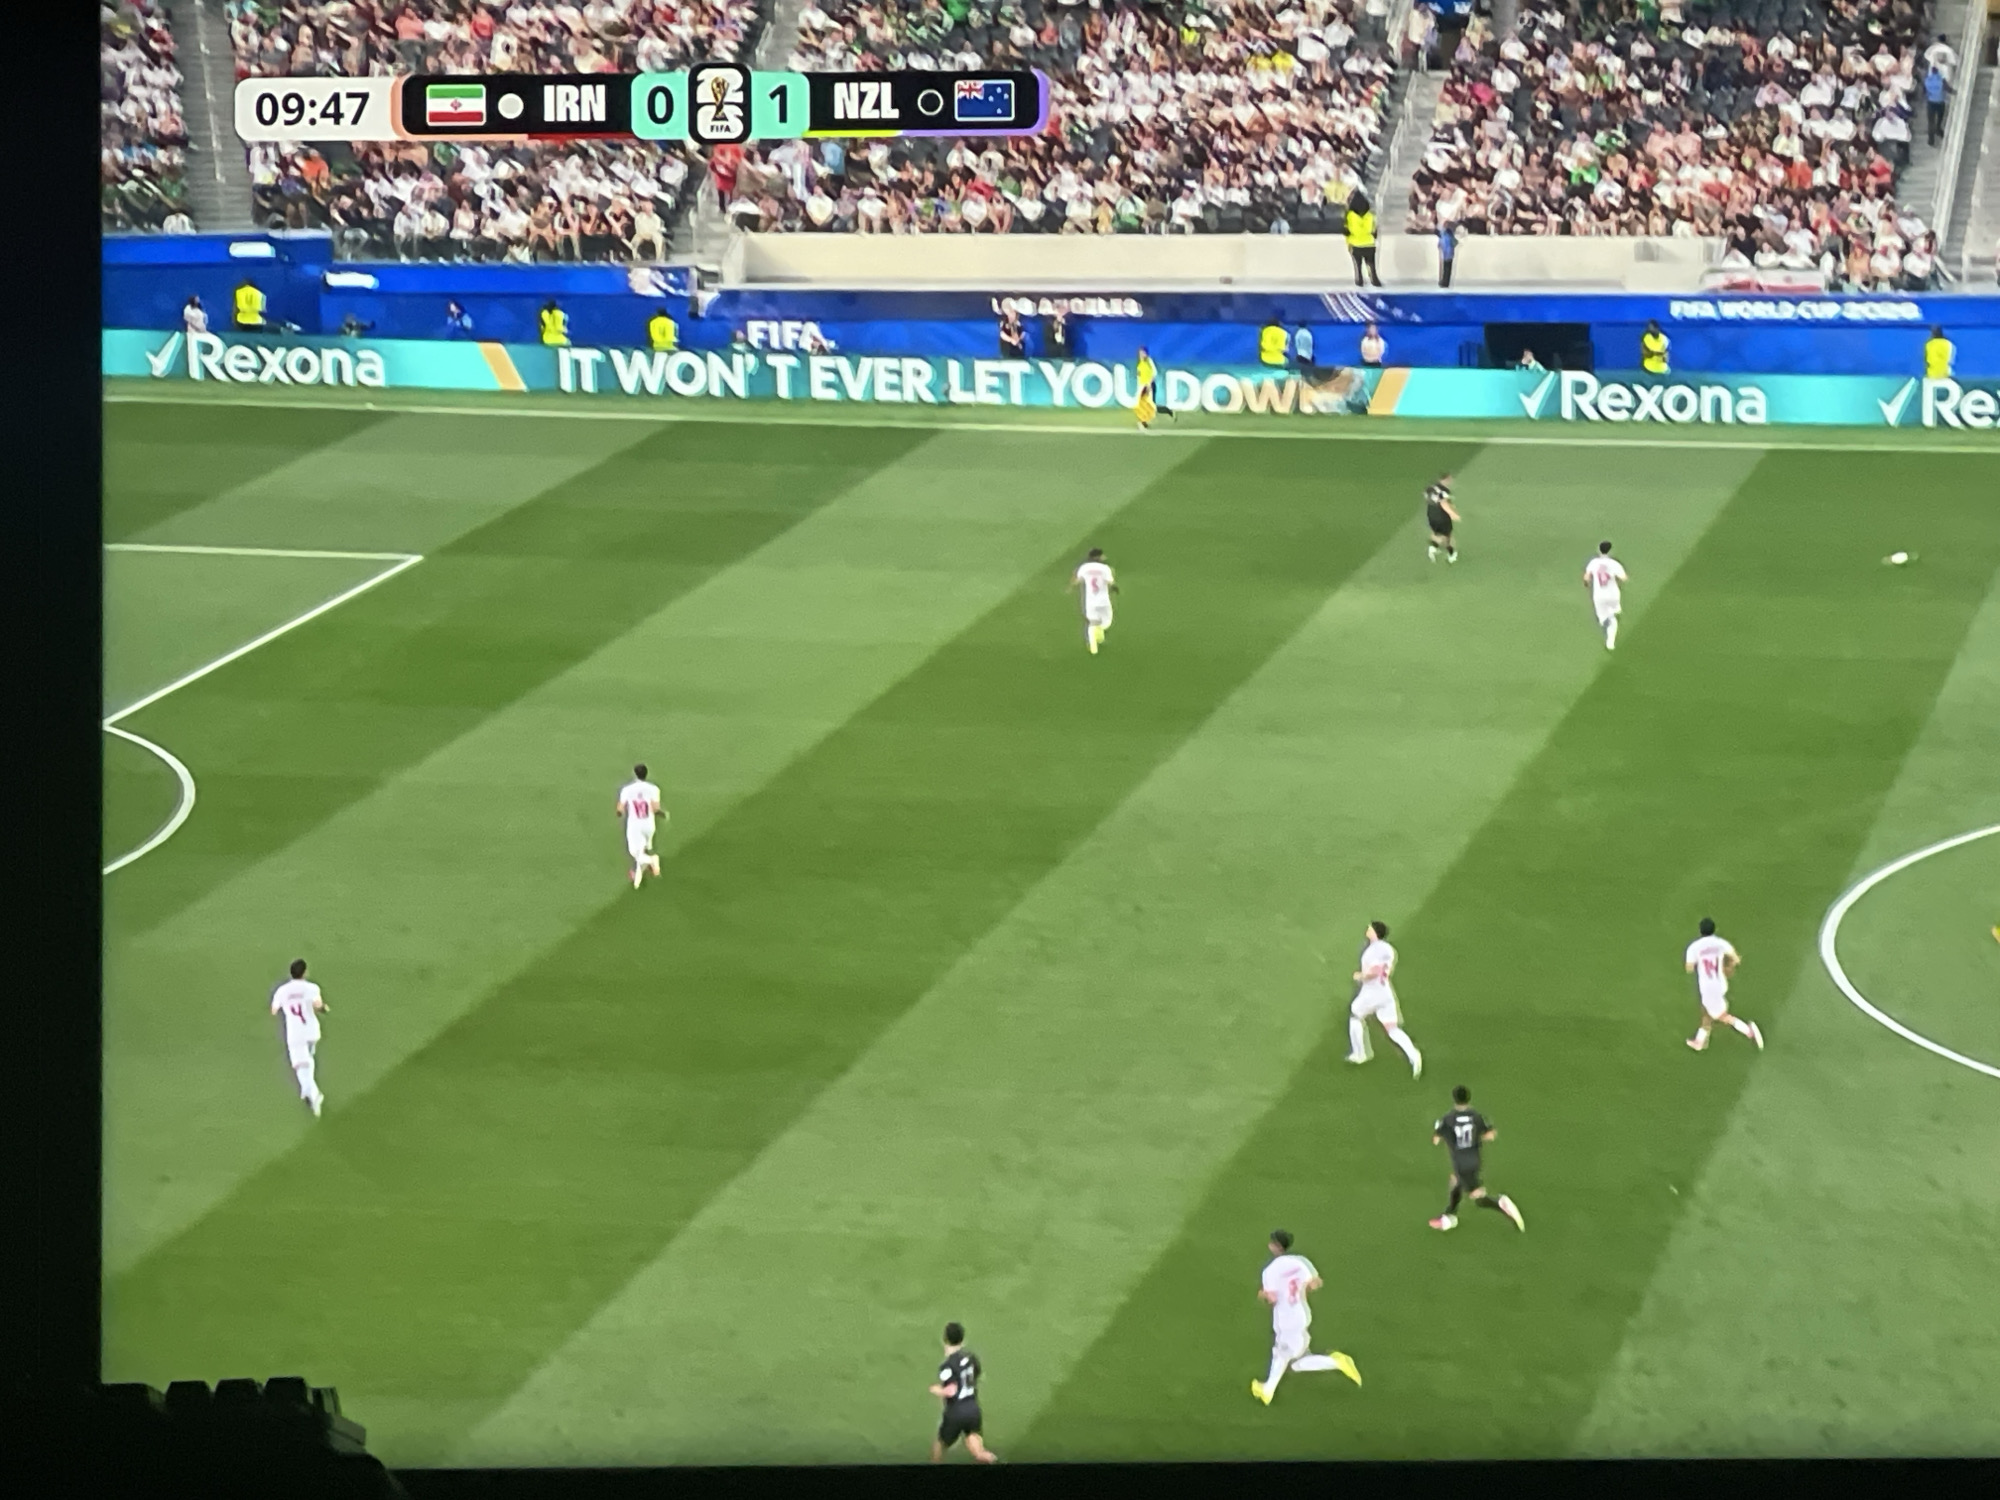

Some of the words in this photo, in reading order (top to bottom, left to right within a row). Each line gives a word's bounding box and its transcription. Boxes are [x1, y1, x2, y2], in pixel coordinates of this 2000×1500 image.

[255, 92, 370, 126] 09:47
[543, 84, 606, 122] IRN
[647, 85, 674, 124] 0
[768, 84, 787, 123] 1
[834, 82, 899, 120] NZL
[710, 124, 732, 133] FIFA
[1717, 300, 1797, 320] WORLD
[1797, 301, 1842, 320] CUP
[747, 320, 831, 352] FIFA
[186, 331, 387, 387] Rexona
[558, 347, 605, 393] IT
[809, 355, 938, 404] EVER
[947, 359, 1033, 405] LET
[1038, 360, 1139, 410] YOU
[1560, 369, 1769, 425] Rexona
[1921, 376, 2000, 432] Re
[290, 1003, 307, 1025] 4
